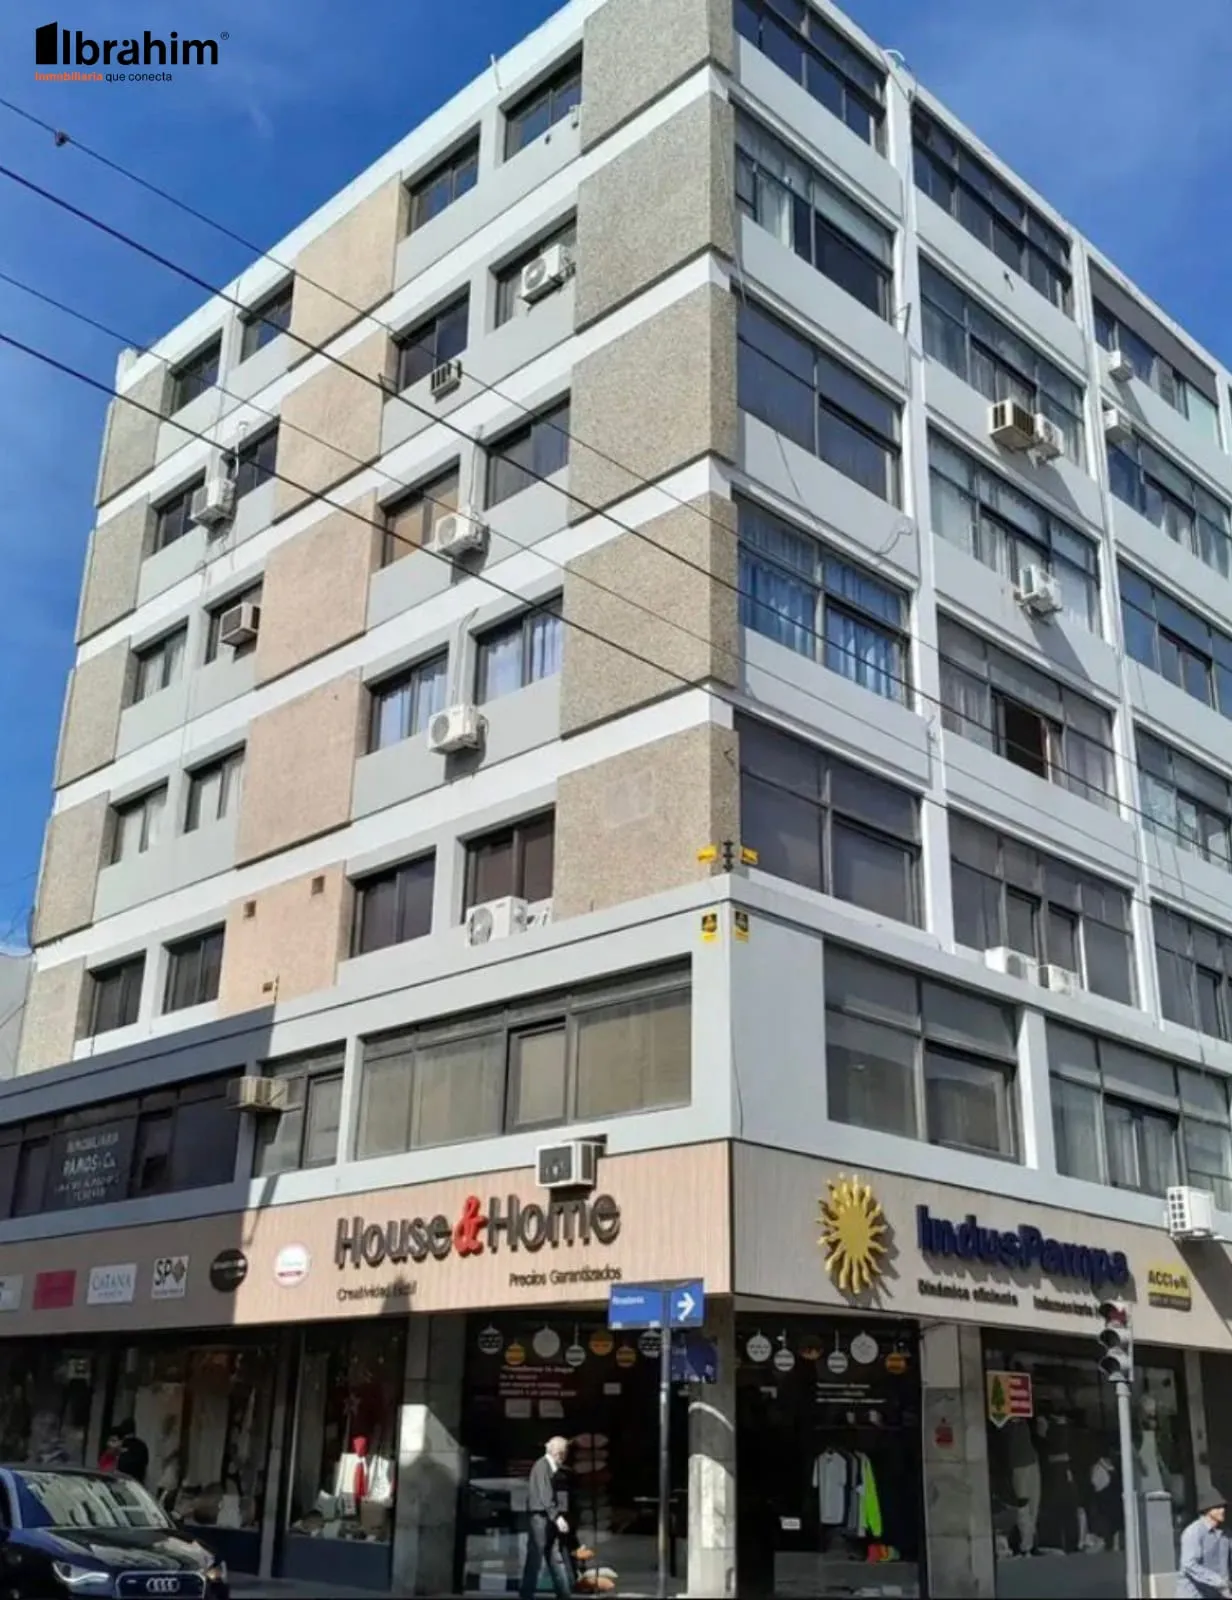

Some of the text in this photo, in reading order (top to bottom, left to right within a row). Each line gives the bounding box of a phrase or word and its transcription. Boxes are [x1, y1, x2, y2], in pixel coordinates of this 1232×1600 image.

[915, 1203, 1131, 1290] IndusPampa
[508, 1263, 623, 1288] Precios Garantizados
